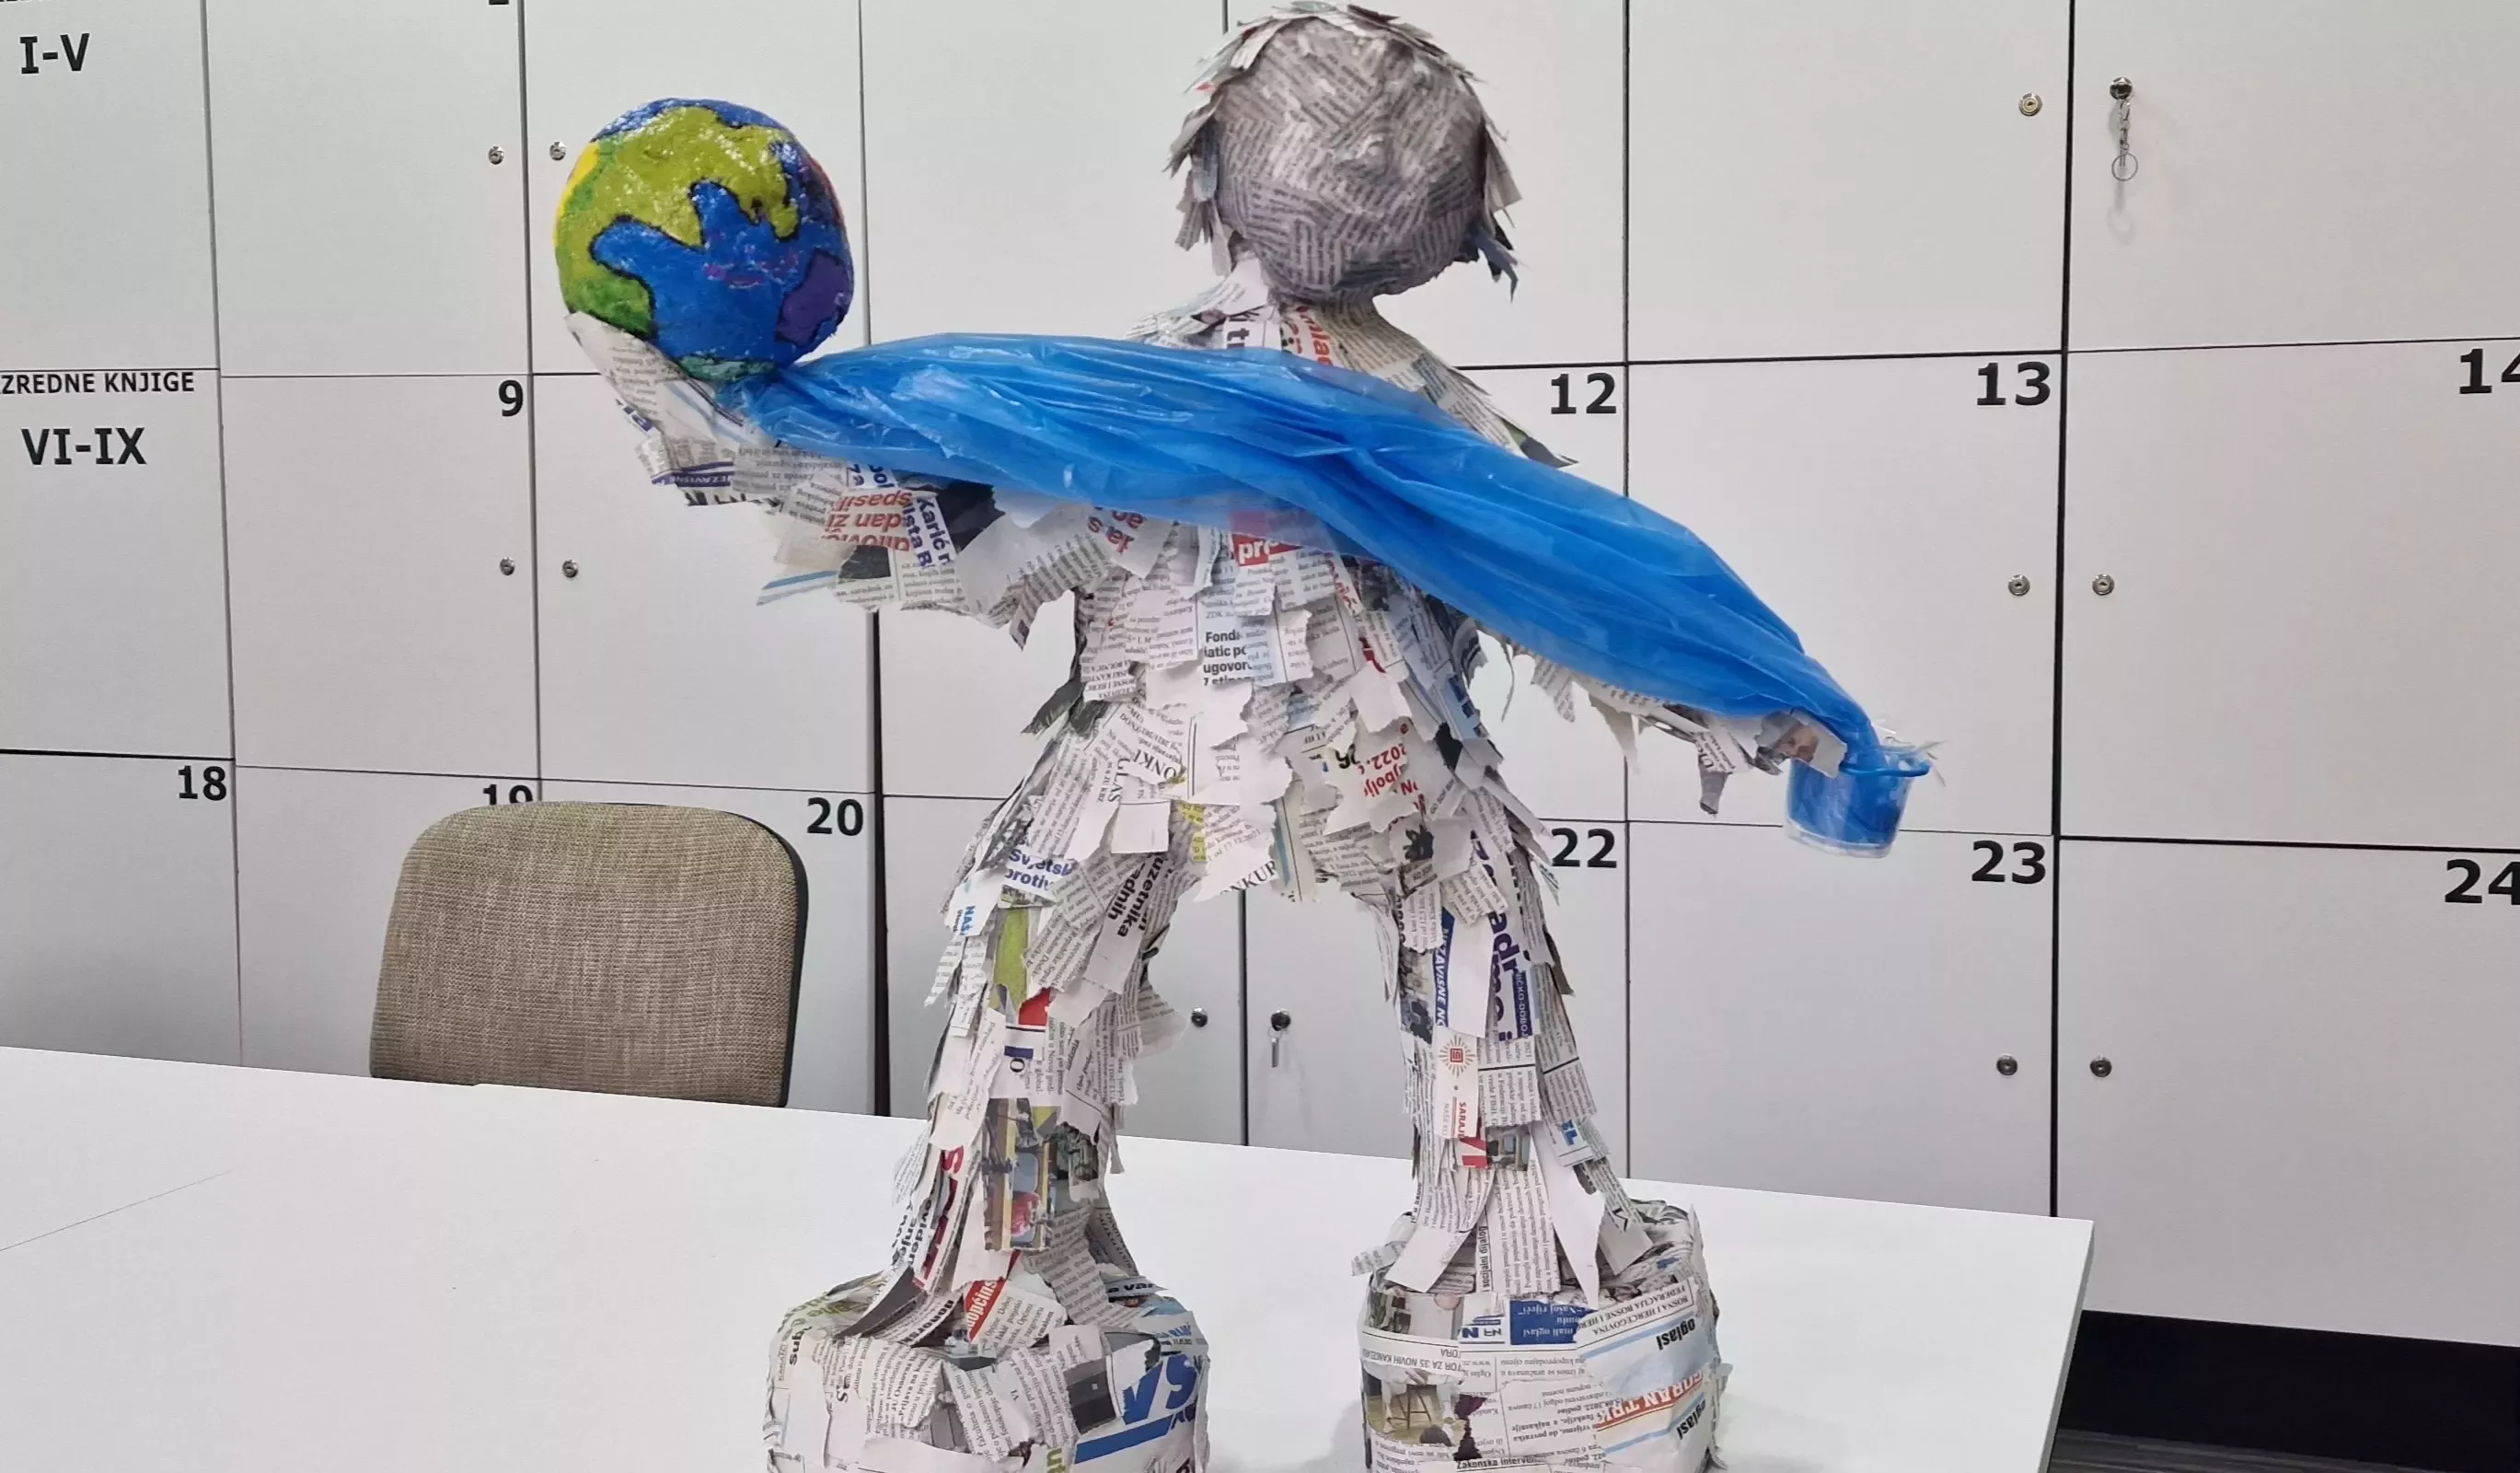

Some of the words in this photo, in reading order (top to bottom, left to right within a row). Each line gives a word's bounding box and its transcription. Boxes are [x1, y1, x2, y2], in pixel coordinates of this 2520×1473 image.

[19, 32, 90, 75] I-V
[1, 372, 96, 395] ZREDNE
[104, 371, 195, 394] KNJIGE
[497, 379, 526, 418] 9
[1550, 373, 1617, 415] 12
[1976, 361, 2052, 407] 13
[21, 426, 146, 466] VI-IX
[177, 765, 227, 801] 18
[806, 796, 864, 836] 20
[1551, 827, 1617, 868] 22
[1971, 840, 2048, 885] 23
[2445, 858, 2520, 906] 24
[1656, 1318, 1696, 1351] oglasi
